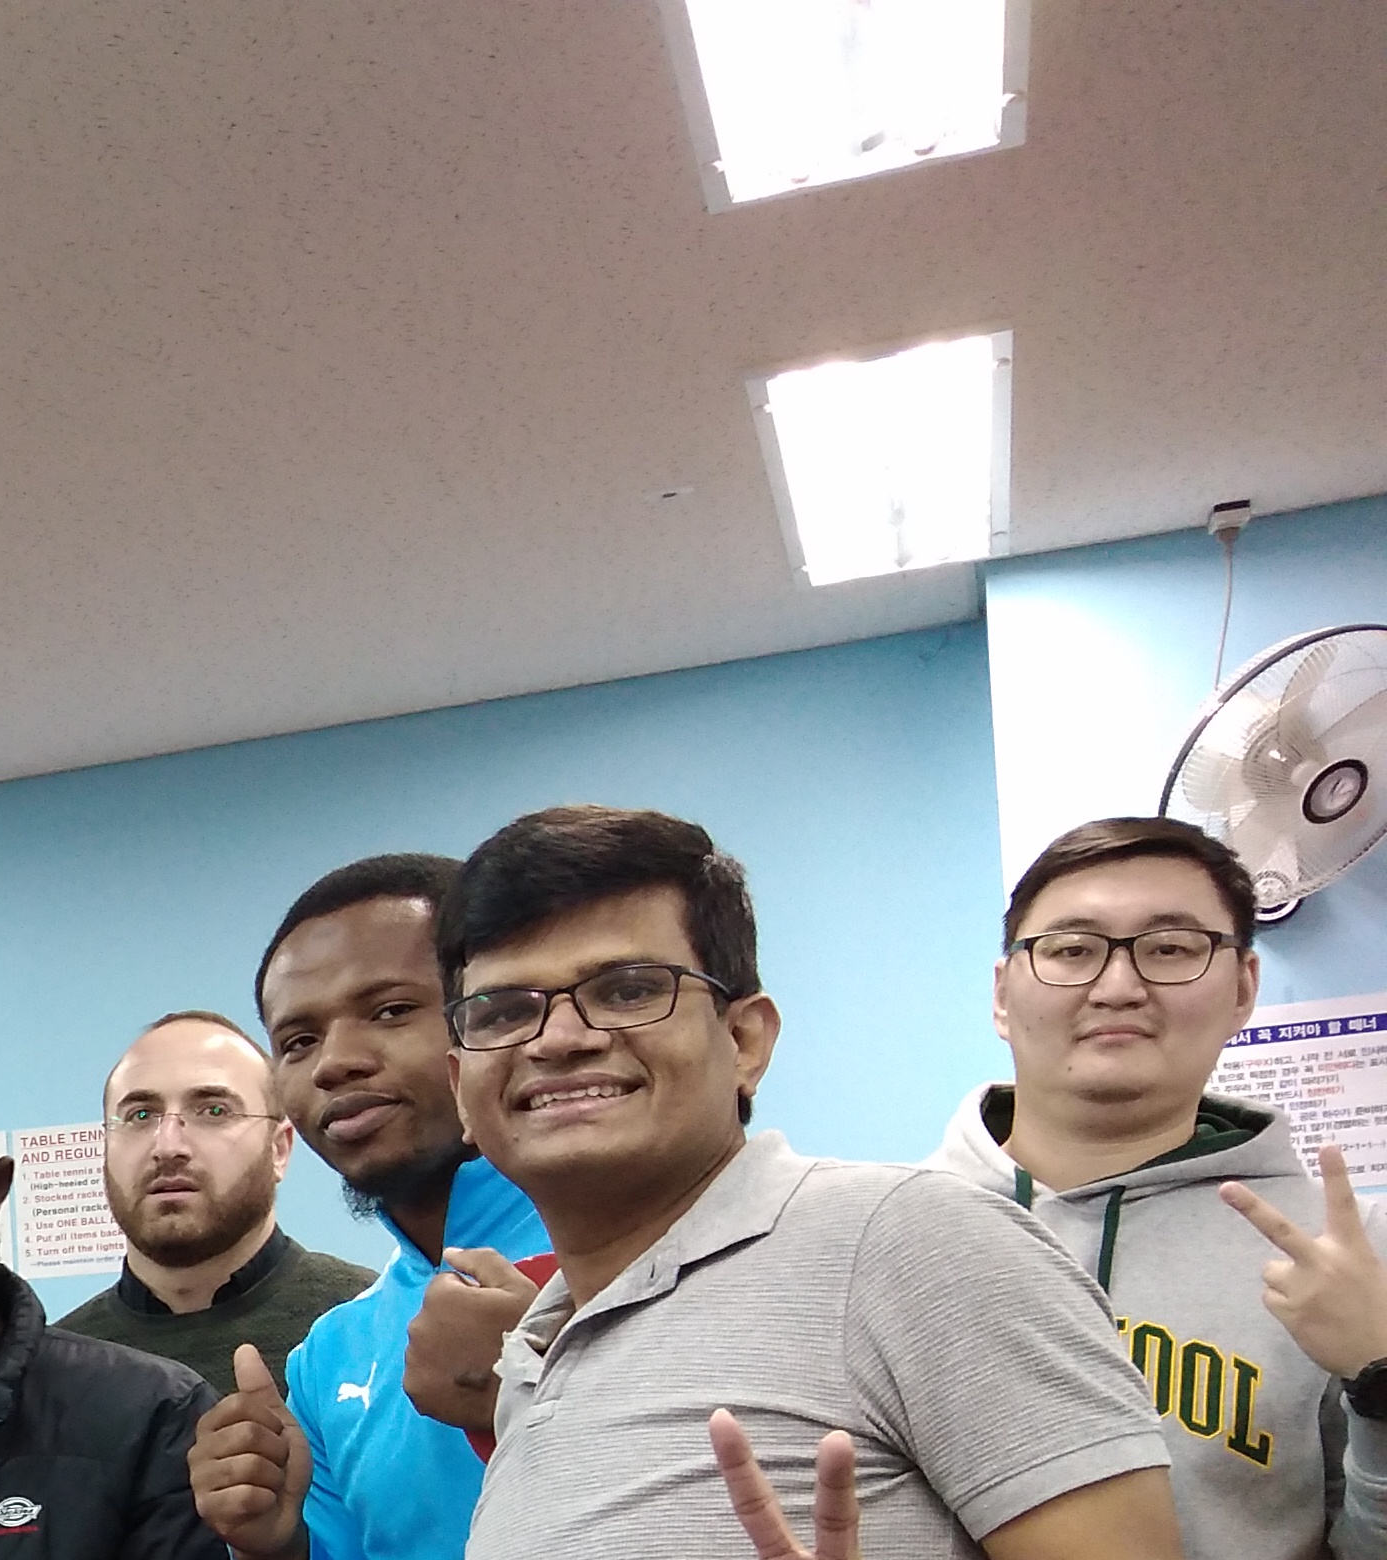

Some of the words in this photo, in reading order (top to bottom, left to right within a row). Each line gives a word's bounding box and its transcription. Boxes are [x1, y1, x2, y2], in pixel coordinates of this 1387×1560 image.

[1257, 1029, 1272, 1042] 꼭
[1278, 1024, 1321, 1039] 지켜야
[1327, 1021, 1341, 1034] 할
[1349, 1017, 1377, 1031] 매너
[1281, 1067, 1299, 1077] 경우
[1275, 1090, 1302, 1101] 반드시
[20, 1133, 66, 1148] TABLE
[70, 1129, 105, 1142] TENN
[21, 1151, 50, 1164] AND
[55, 1147, 105, 1160] REGUL
[33, 1170, 60, 1180] Table
[63, 1167, 93, 1177] tennis
[34, 1192, 74, 1204] Stocked
[77, 1190, 104, 1198] racke
[32, 1206, 79, 1216] (Personal
[24, 1222, 33, 1231] 3.
[36, 1221, 54, 1230] Use
[57, 1218, 77, 1228] ONE
[81, 1216, 107, 1226] BALL
[36, 1234, 52, 1244] Put
[55, 1232, 67, 1241] all
[70, 1230, 97, 1240] items
[100, 1228, 125, 1238] back
[37, 1248, 59, 1257] Turn
[62, 1246, 75, 1254] off
[77, 1244, 93, 1253] the
[96, 1242, 125, 1252] lights
[63, 1258, 95, 1266] maintain
[1114, 1315, 1274, 1470] OOL
